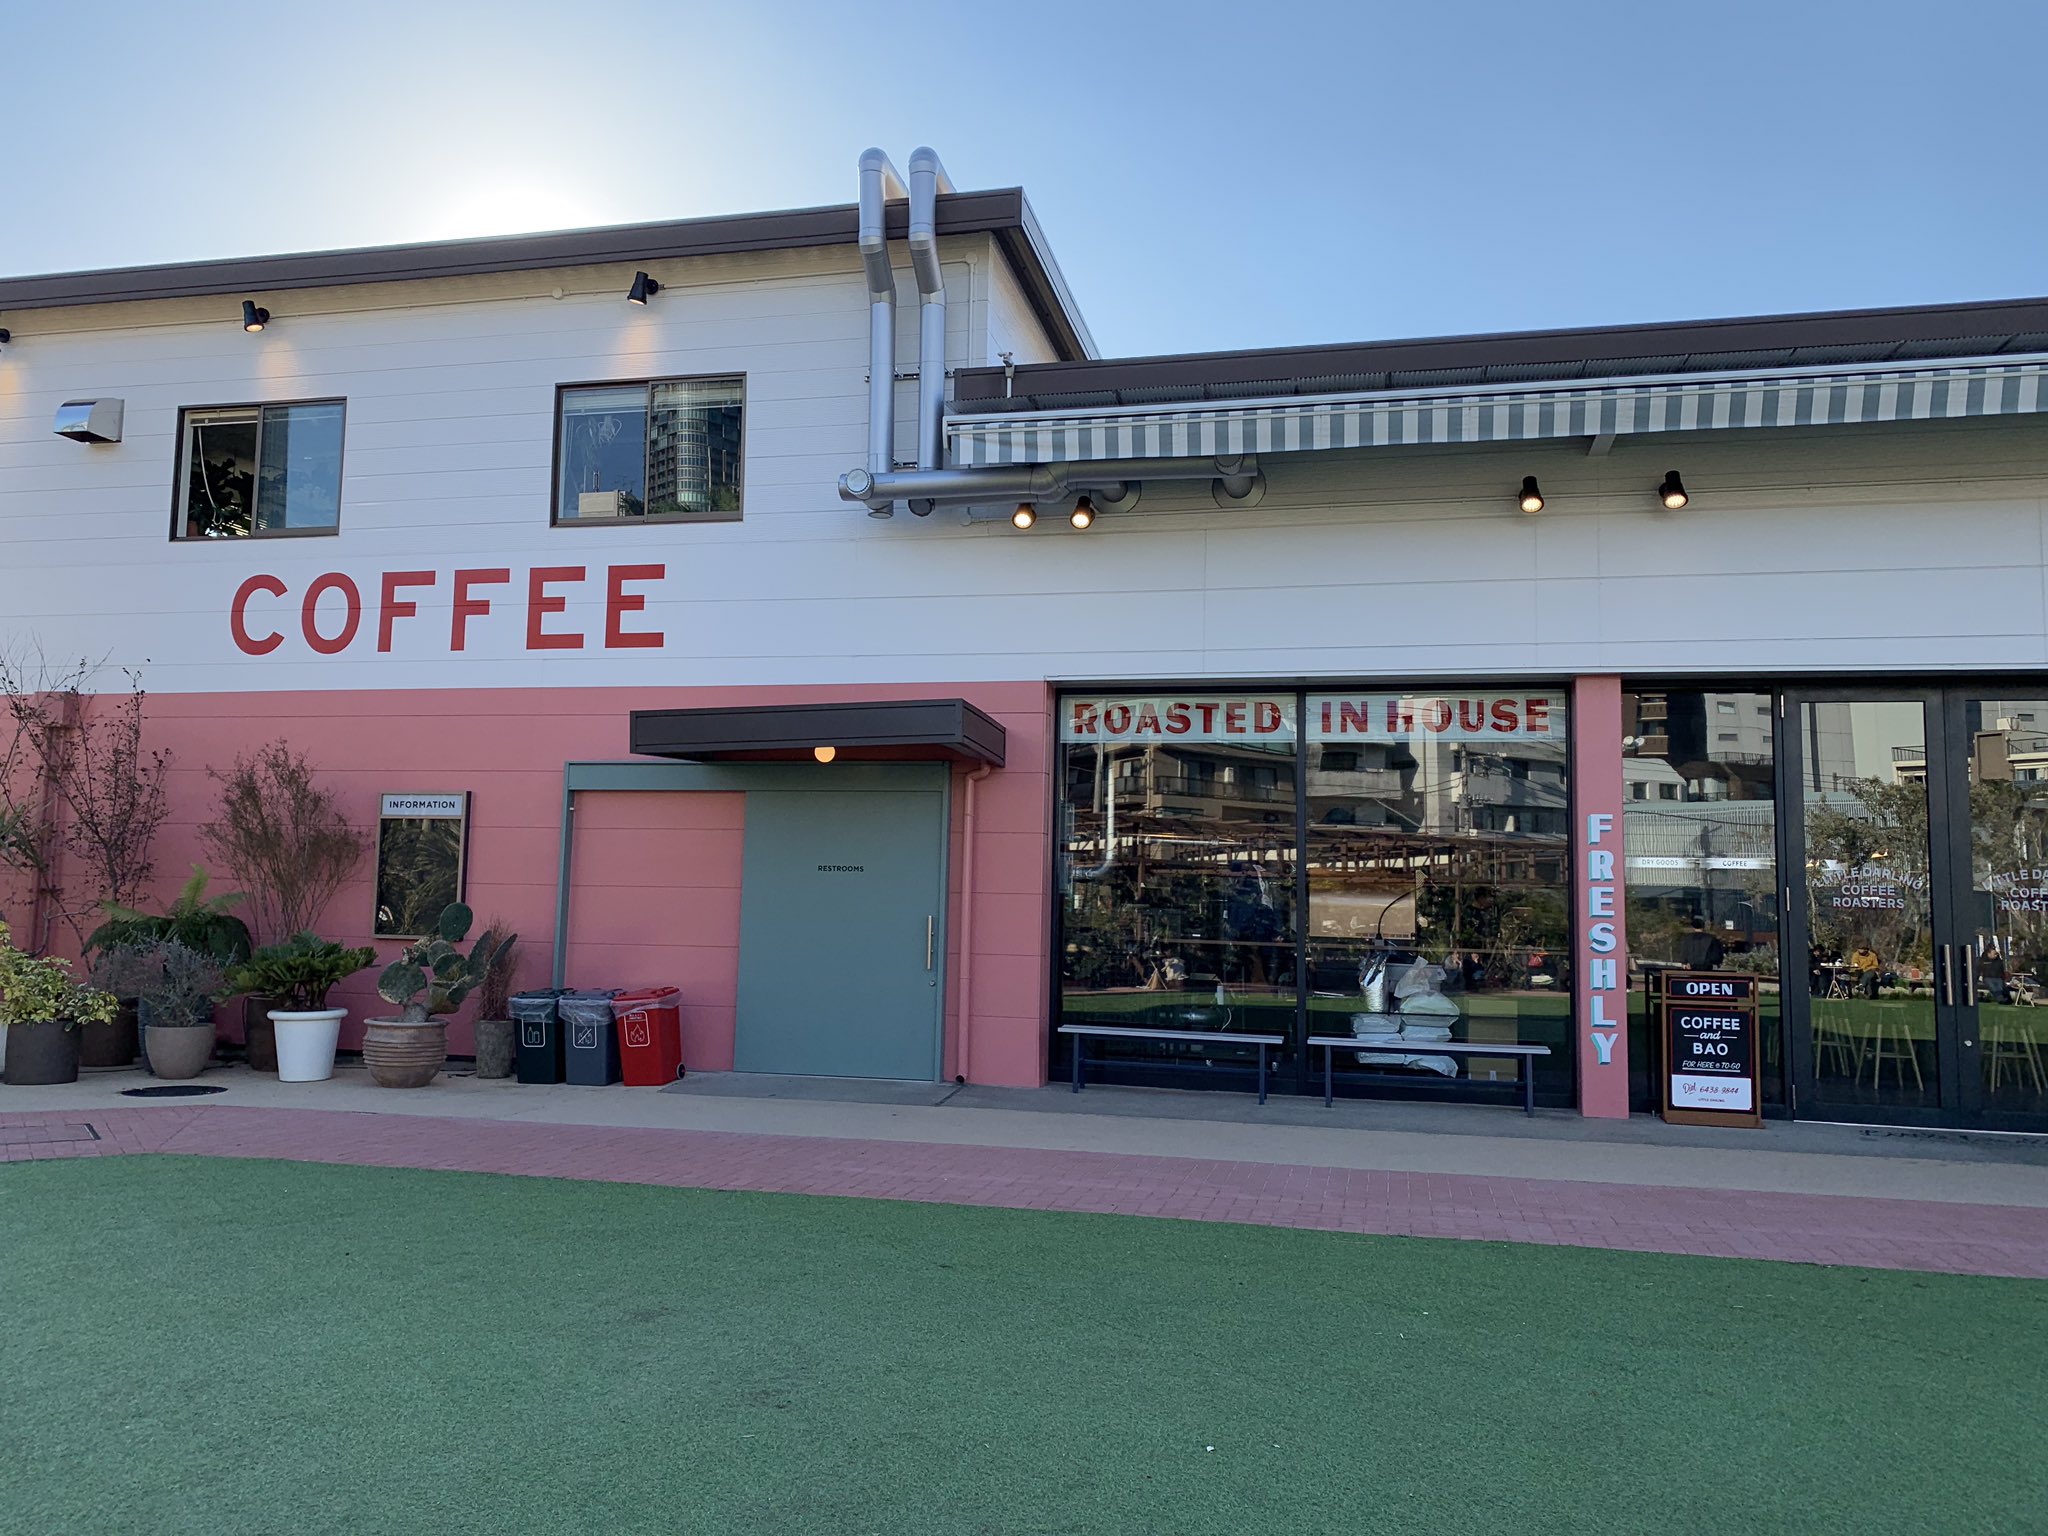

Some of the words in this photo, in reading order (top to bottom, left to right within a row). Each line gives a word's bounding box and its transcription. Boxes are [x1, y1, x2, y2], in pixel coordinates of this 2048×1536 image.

[230, 564, 666, 656] COFFEE
[1073, 701, 1283, 735] ROASTED
[1321, 700, 1369, 734] IN
[1386, 699, 1550, 734] HOUSE
[389, 800, 456, 809] INFORMATION
[817, 865, 865, 873] RESTROOMS
[1862, 867, 1923, 890] DARLING
[1841, 884, 1896, 896] COFFEE
[1832, 896, 1905, 909] ROASTERS
[1587, 813, 1618, 1064] FRESHLY
[1685, 982, 1734, 996] OPEN
[1680, 1016, 1741, 1031] COFFEE
[1699, 1030, 1721, 1040] and
[1692, 1042, 1729, 1056] BAO
[1682, 1060, 1696, 1068] FOR
[1696, 1061, 1715, 1069] HERE
